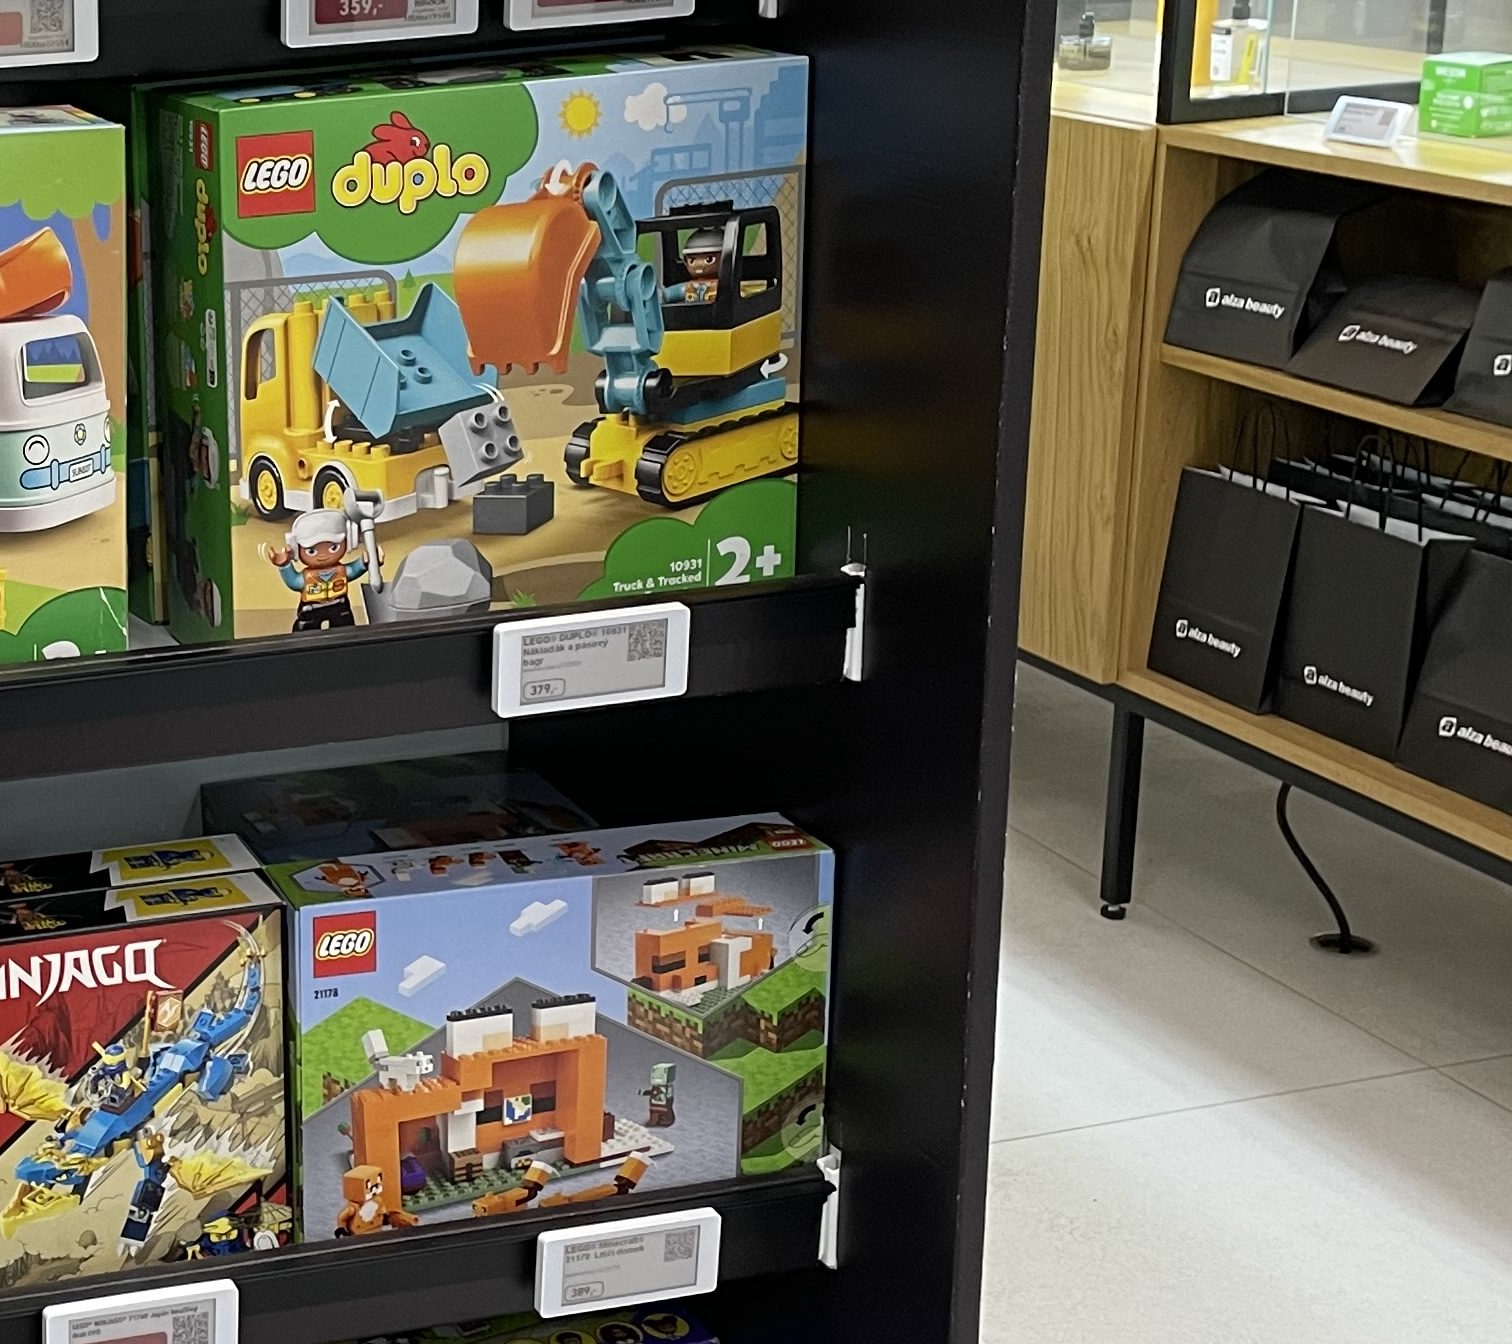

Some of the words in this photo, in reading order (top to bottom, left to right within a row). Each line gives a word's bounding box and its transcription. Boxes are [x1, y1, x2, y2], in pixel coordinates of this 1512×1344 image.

[200, 123, 209, 170] LEGO
[240, 154, 311, 192] LEGO
[331, 140, 491, 214] duplo
[194, 178, 209, 276] duplo
[1221, 293, 1244, 309] alza
[1245, 298, 1285, 319] beauty
[1378, 334, 1418, 355] beauty
[670, 558, 702, 573] 10931
[714, 536, 782, 586] 2+
[613, 580, 643, 593] Truck
[645, 578, 655, 588] &
[658, 572, 702, 587] Tracked
[1188, 627, 1208, 643] alza
[1207, 633, 1241, 658] beauty
[530, 684, 558, 696] 379,-
[1318, 673, 1339, 692] alza
[1337, 681, 1374, 707] beauty
[1457, 725, 1484, 747] alza
[316, 926, 373, 959] LEGO
[314, 987, 339, 1001] 21178
